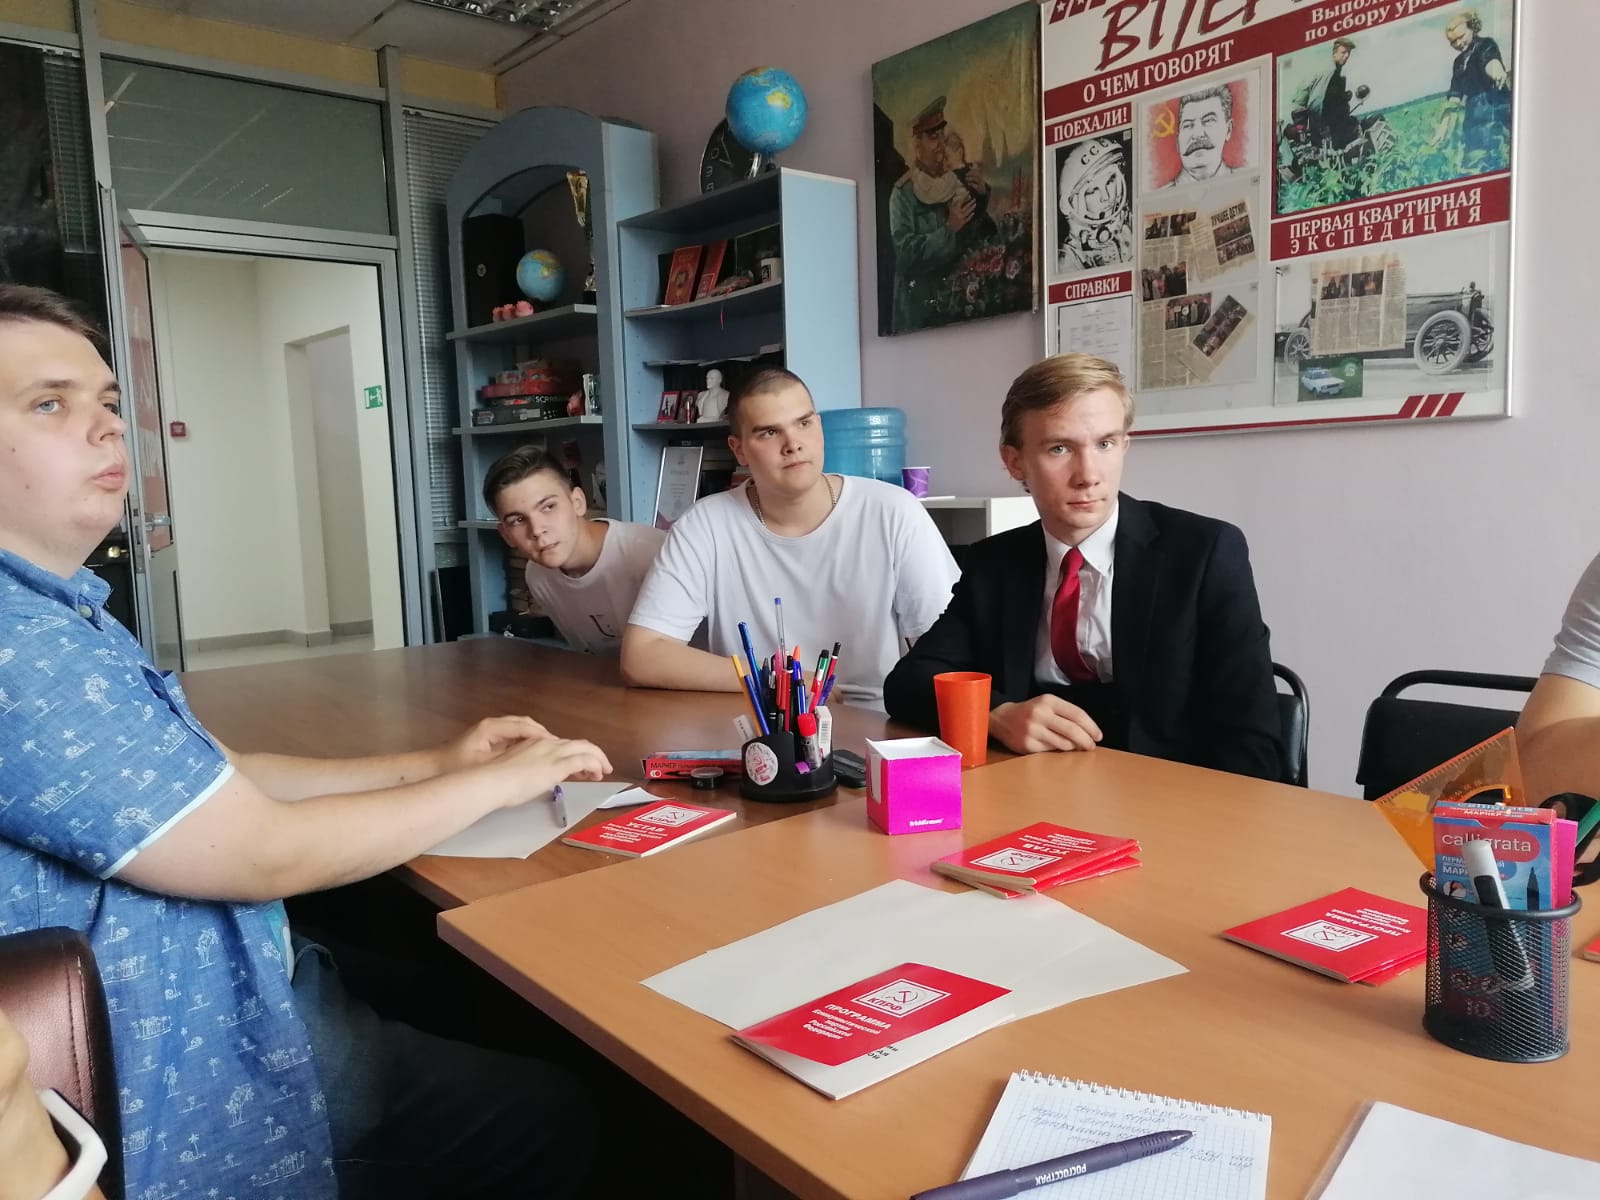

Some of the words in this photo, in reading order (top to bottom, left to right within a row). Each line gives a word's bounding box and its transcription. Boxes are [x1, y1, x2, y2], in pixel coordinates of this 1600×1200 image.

[1305, 26, 1328, 42] по
[1333, 5, 1390, 33] сбору
[1083, 83, 1095, 103] О
[1100, 68, 1139, 98] ЧЕМ
[1143, 39, 1235, 86] ГОВОРЯТ
[1053, 107, 1128, 142] ПОЕХАЛИ!
[1290, 212, 1354, 239] ПЕРВАЯ
[1358, 187, 1482, 226] КВАРТИРНАЯ
[1290, 205, 1482, 255] ЭКСПЕДИЦИЯ
[1065, 277, 1121, 300] СПРАВКИ
[625, 821, 666, 833] УСТАВ
[824, 1003, 893, 1030] ПРОГРАММА
[867, 997, 904, 1012] КПРФ
[1034, 1162, 1088, 1186] РОСГОССТРАХ
